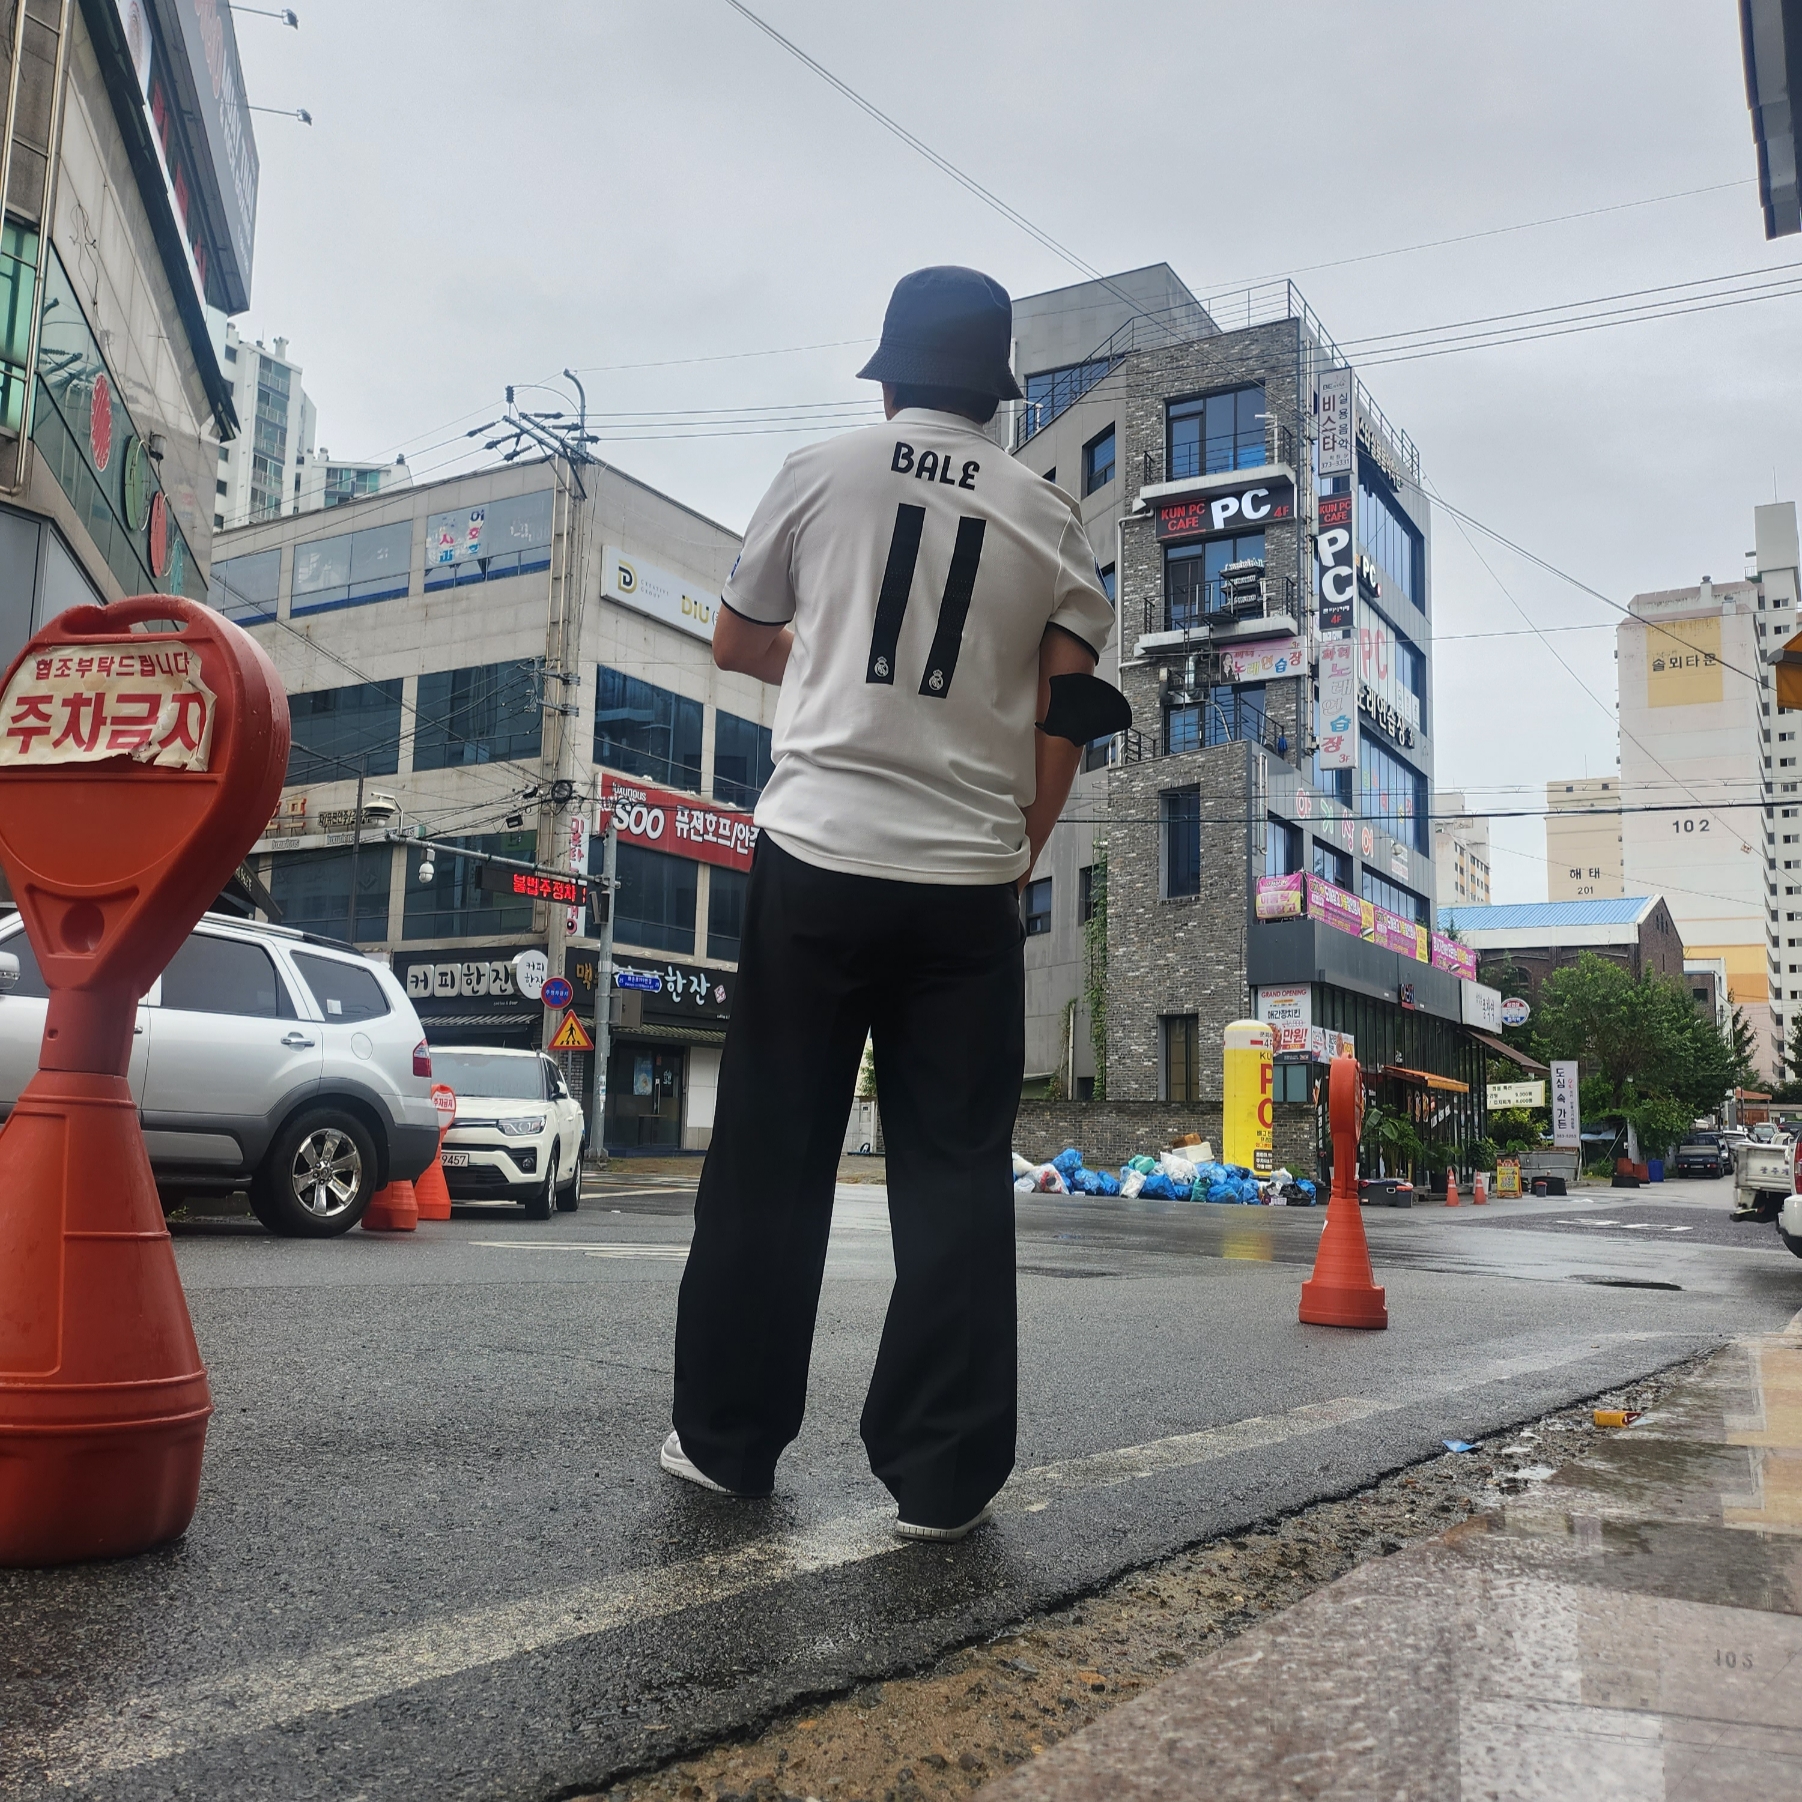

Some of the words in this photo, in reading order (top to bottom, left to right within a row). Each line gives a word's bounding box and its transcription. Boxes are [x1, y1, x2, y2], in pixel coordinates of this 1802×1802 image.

[1322, 395, 1337, 452] 비스타
[1338, 392, 1348, 449] 실용음악
[891, 441, 980, 491] BALE
[1161, 506, 1186, 521] KUN
[1189, 503, 1206, 515] PC
[1211, 488, 1271, 529] PC
[1273, 505, 1289, 518] 4F
[1319, 503, 1337, 515] KUN
[1339, 500, 1352, 511] PC
[1168, 516, 1199, 532] CAFE
[1324, 512, 1348, 523] CAFE
[1317, 528, 1354, 604] PC
[1362, 555, 1377, 587] PC
[866, 502, 987, 699] 11
[1331, 614, 1342, 624] 4F
[1234, 650, 1302, 676] 노래연습장
[1361, 628, 1388, 680] PC
[1652, 654, 1717, 672] 솔뫼타운
[35, 651, 191, 681] 협조부탁드립니다
[1321, 664, 1353, 754] 노래연습장
[6, 692, 207, 754] 주차금지
[1339, 753, 1350, 763] 3F
[613, 799, 665, 840] SOO
[1673, 819, 1710, 833] 102
[513, 874, 576, 902] 불법주정차
[1577, 886, 1594, 895] 201
[526, 961, 545, 973] 커피
[524, 973, 546, 989] 한잔
[664, 965, 711, 1005] 한잔
[1261, 990, 1280, 998] GRAND
[1283, 1028, 1308, 1043] 만원!
[1556, 1068, 1566, 1089] 도심
[434, 1098, 453, 1109] 주차금지
[1557, 1093, 1566, 1104] 속
[1557, 1108, 1567, 1130] 가든
[441, 1154, 467, 1167] 9457
